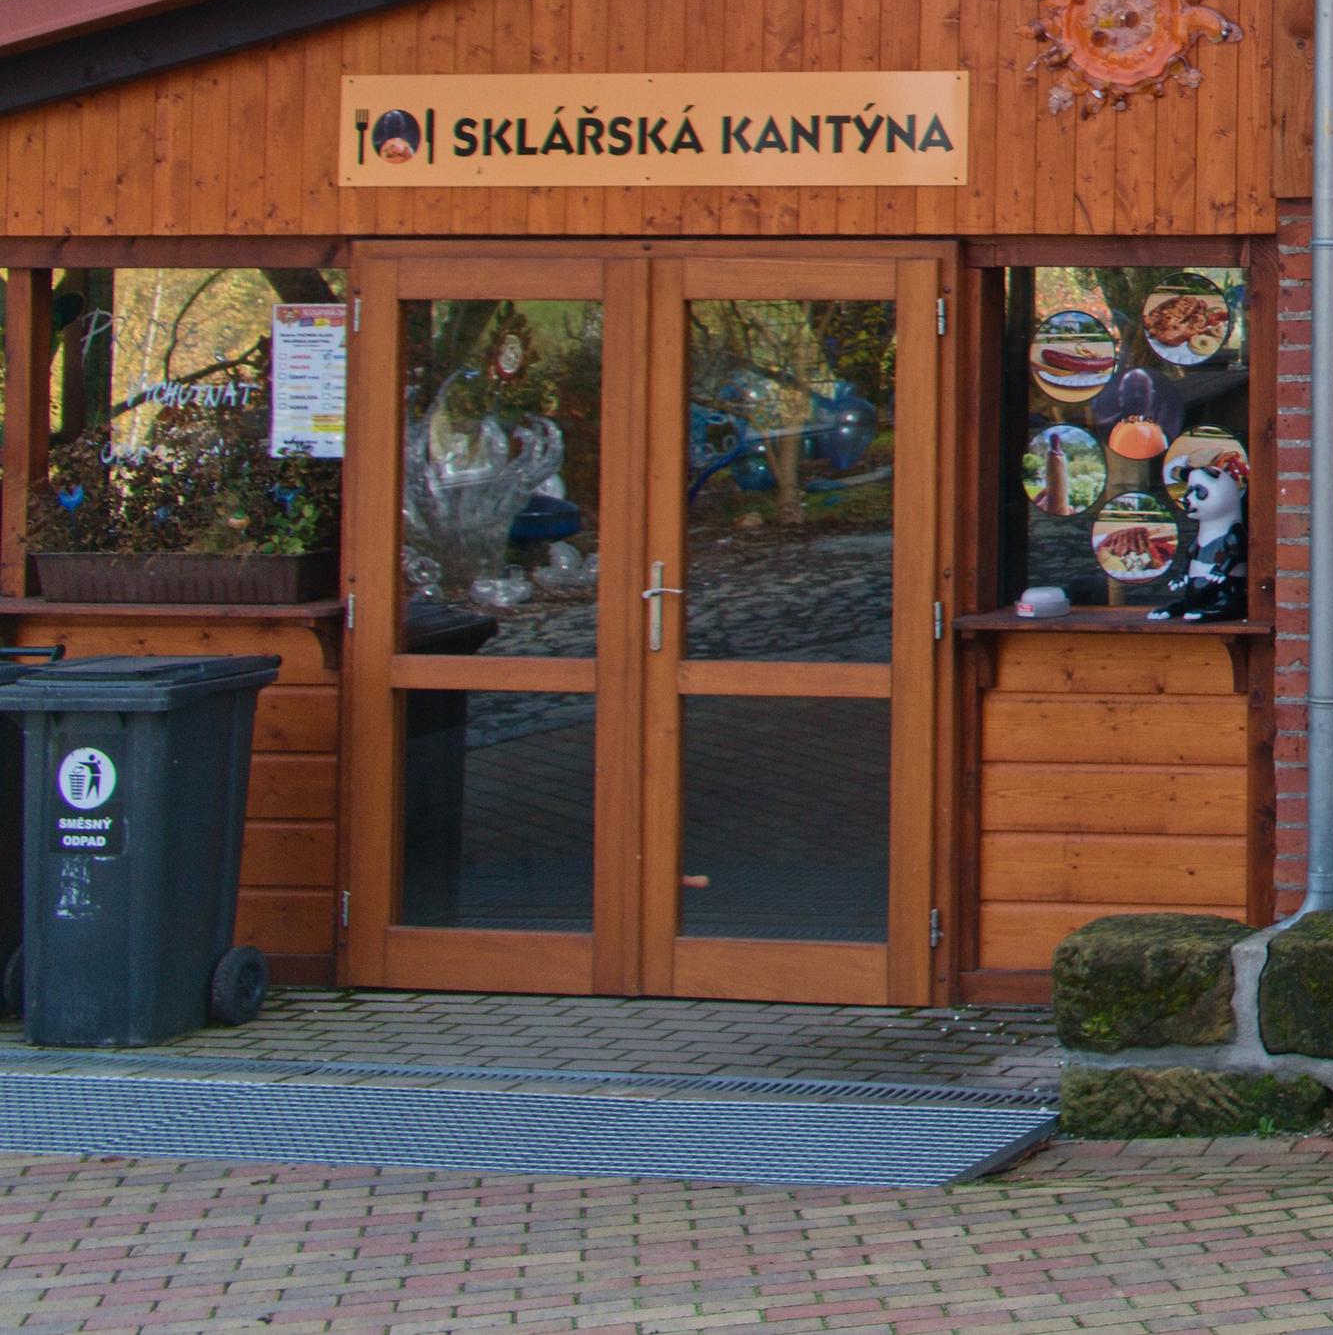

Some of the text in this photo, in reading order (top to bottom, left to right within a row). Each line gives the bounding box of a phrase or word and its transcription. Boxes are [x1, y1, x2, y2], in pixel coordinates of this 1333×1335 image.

[453, 103, 955, 157] SKLÁŘSKÁ KANTÝNA
[58, 816, 113, 830] SMĚSNÝ
[62, 835, 107, 847] ODPAD
